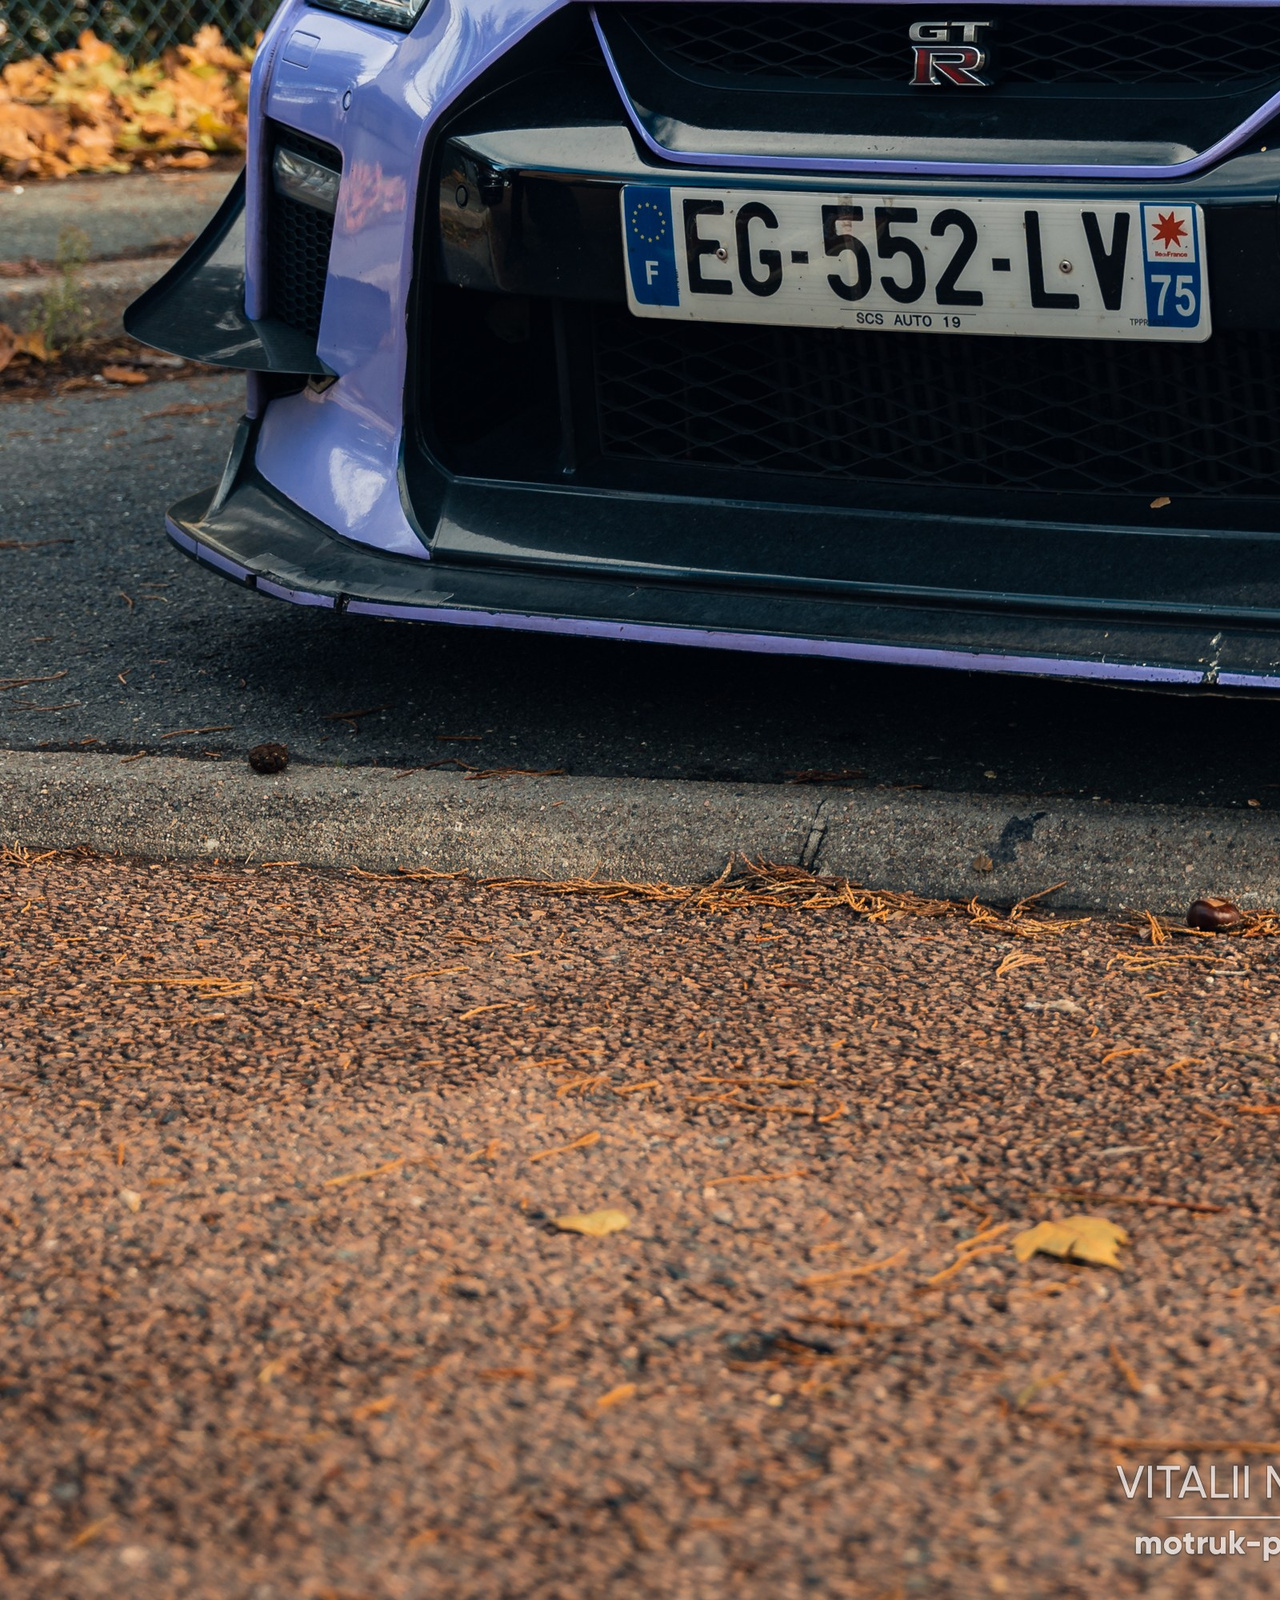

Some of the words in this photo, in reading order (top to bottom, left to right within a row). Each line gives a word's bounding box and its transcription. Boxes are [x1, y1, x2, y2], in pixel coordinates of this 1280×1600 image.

[682, 198, 1130, 311] EG-552-LV
[645, 260, 659, 286] F
[1150, 274, 1197, 317] 75
[856, 312, 884, 325] SCS
[894, 314, 933, 327] AUTO
[943, 316, 961, 328] 19
